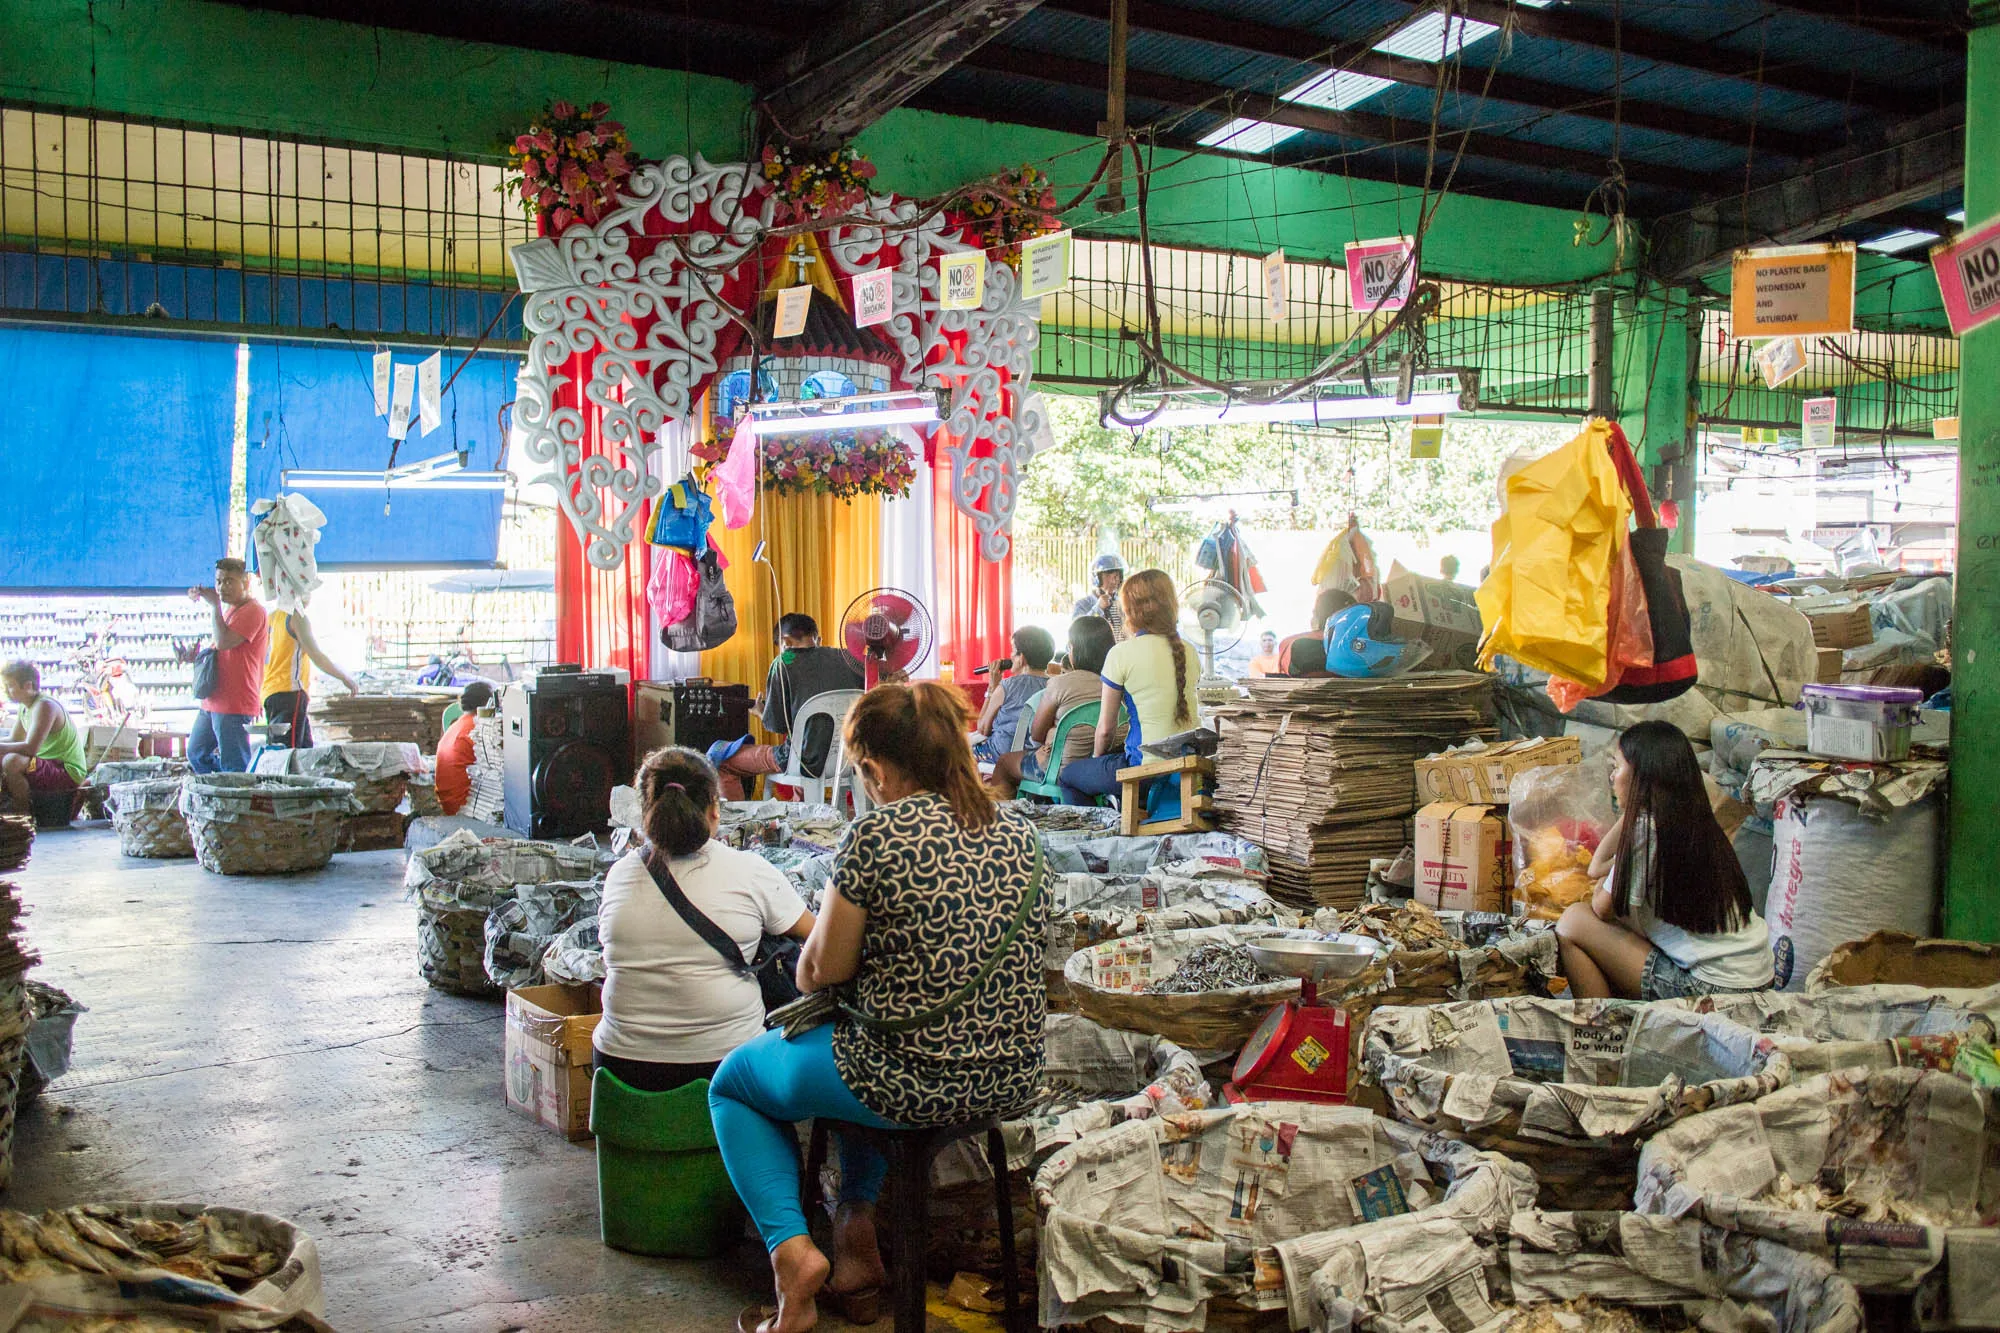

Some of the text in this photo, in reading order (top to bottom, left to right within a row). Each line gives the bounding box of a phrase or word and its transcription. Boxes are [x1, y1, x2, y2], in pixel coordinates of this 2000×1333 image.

[1364, 260, 1385, 284] NO
[1756, 264, 1827, 278] NO PLASTIC BAGS
[1963, 247, 2000, 288] NO
[949, 268, 962, 286] NO
[1756, 281, 1807, 293] WEDNESDAY
[862, 286, 875, 304] NO
[1756, 300, 1774, 308] AND
[1756, 313, 1799, 324] SATURDAY
[1810, 406, 1820, 415] NO
[1779, 838, 1803, 929] Integra
[1574, 1028, 1606, 1041] Rody
[1609, 1030, 1622, 1041] to
[1573, 1041, 1625, 1054] Do what
